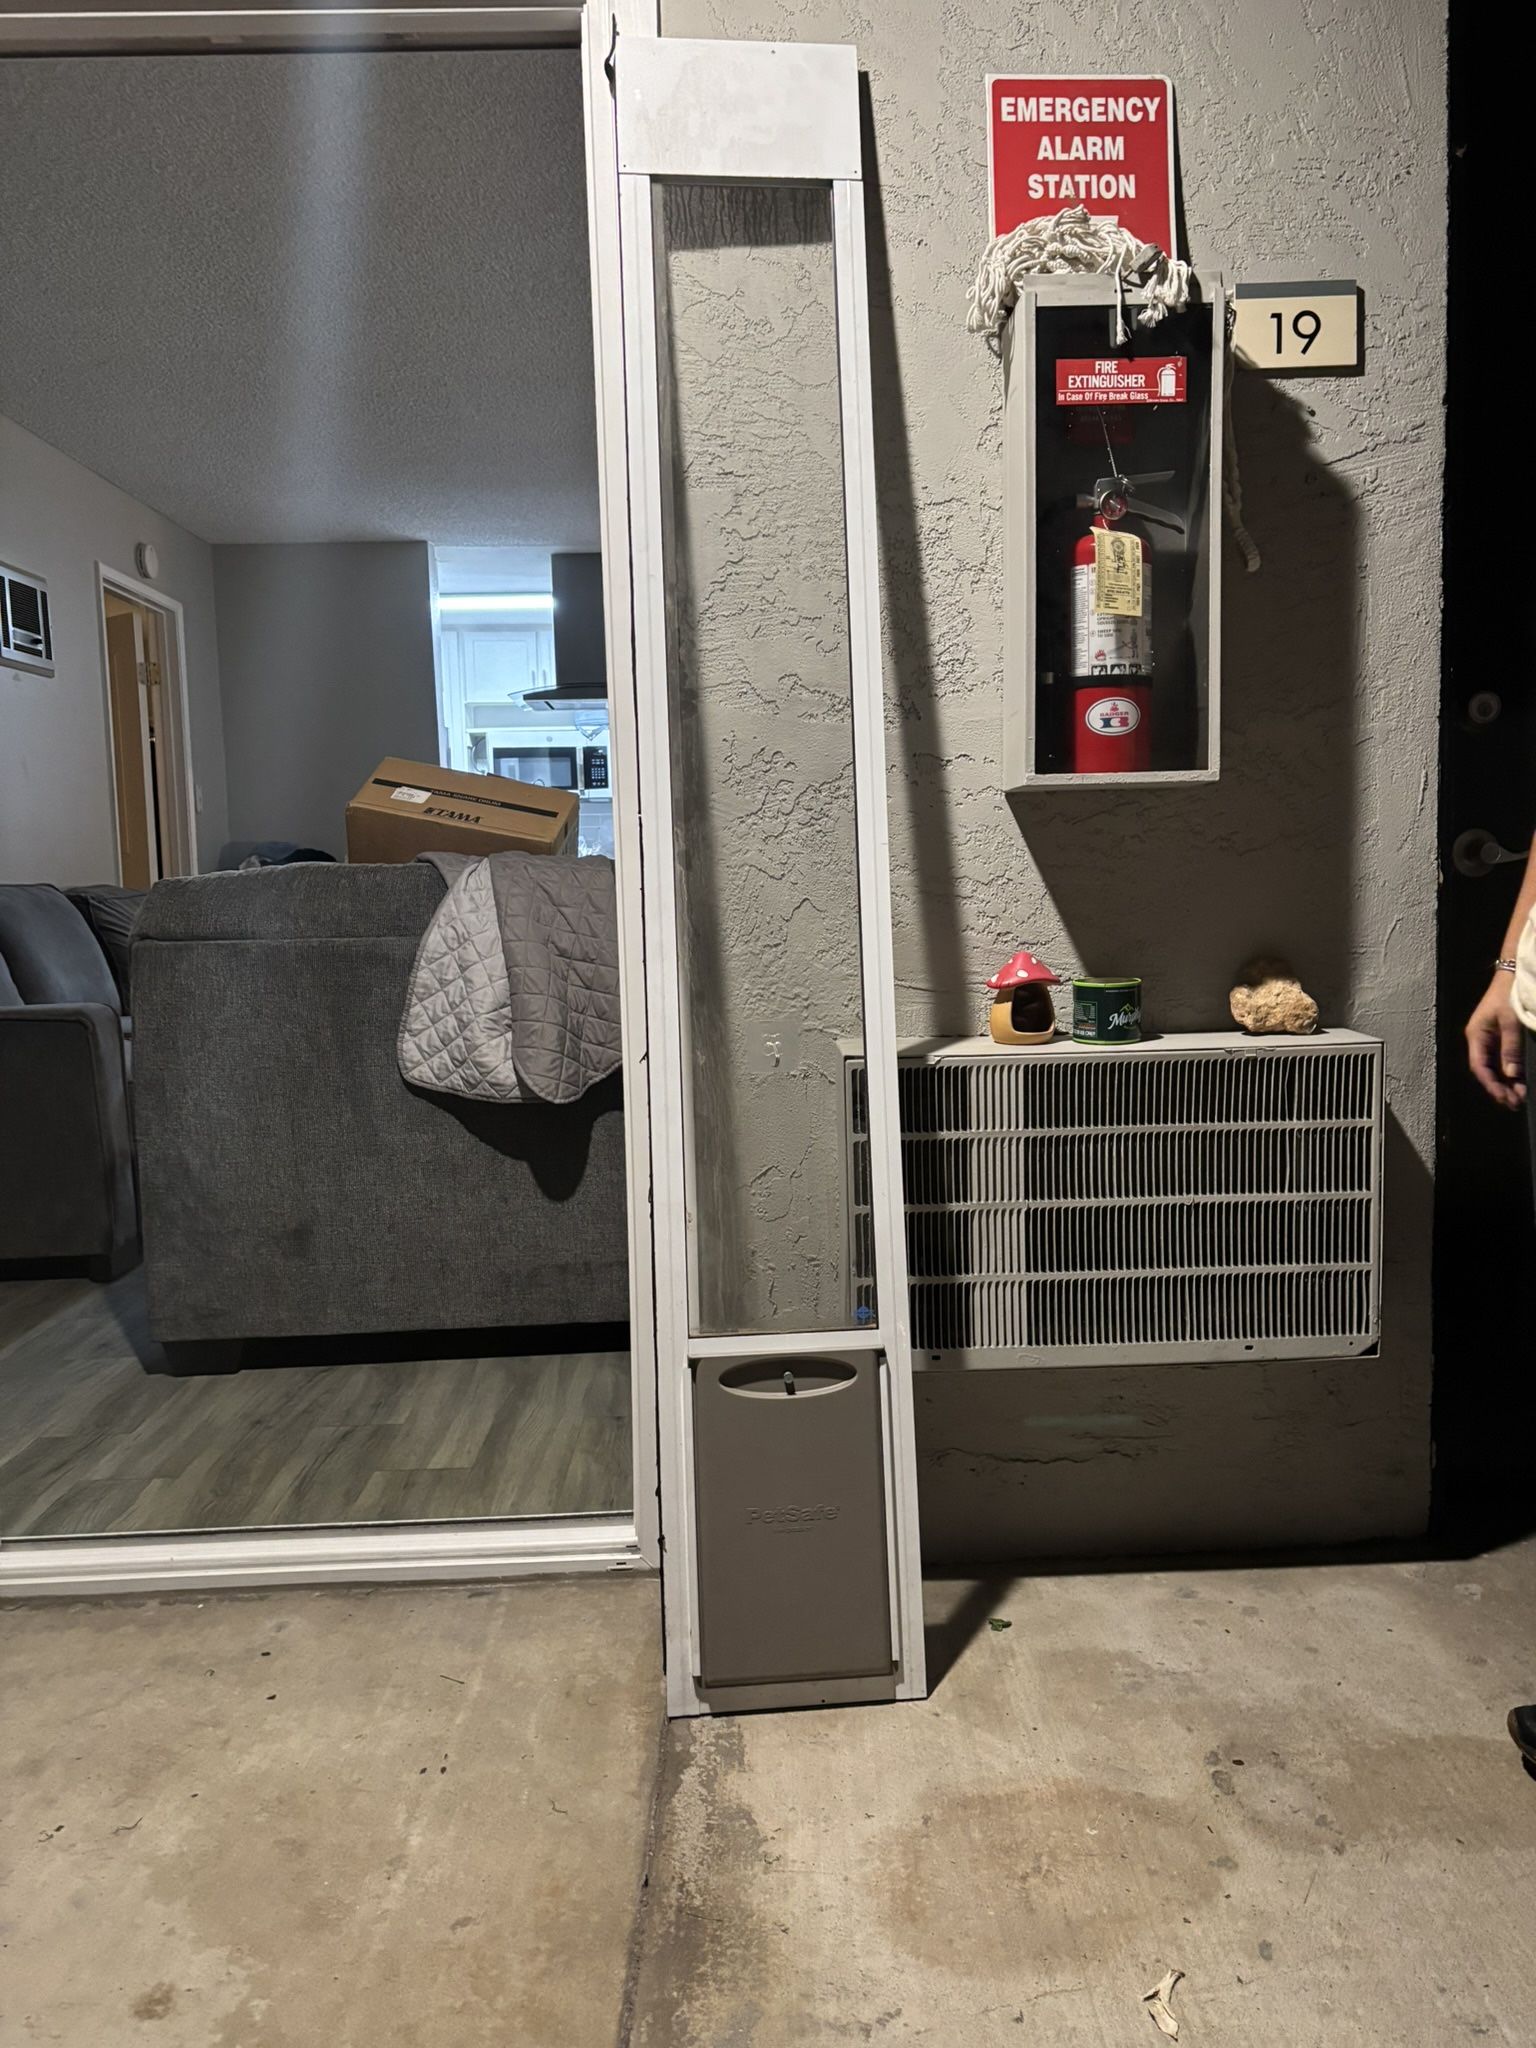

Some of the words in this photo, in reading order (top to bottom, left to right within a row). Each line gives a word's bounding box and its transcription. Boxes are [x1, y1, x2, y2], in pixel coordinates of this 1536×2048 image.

[1001, 97, 1160, 122] EMERGENCY
[1037, 136, 1124, 160] ALARM
[1028, 174, 1136, 199] STATION
[1270, 310, 1321, 355] 19
[1095, 361, 1118, 373] FIRE
[1068, 374, 1145, 388] EXTINGUISHER
[1058, 393, 1065, 401] In
[1066, 393, 1083, 401] Case
[1085, 392, 1093, 400] Of
[1095, 392, 1107, 401] Fire
[1109, 391, 1128, 400] Break
[1130, 391, 1148, 400] Glass
[434, 807, 482, 824] TAMA
[744, 1503, 838, 1524] PetSafe
